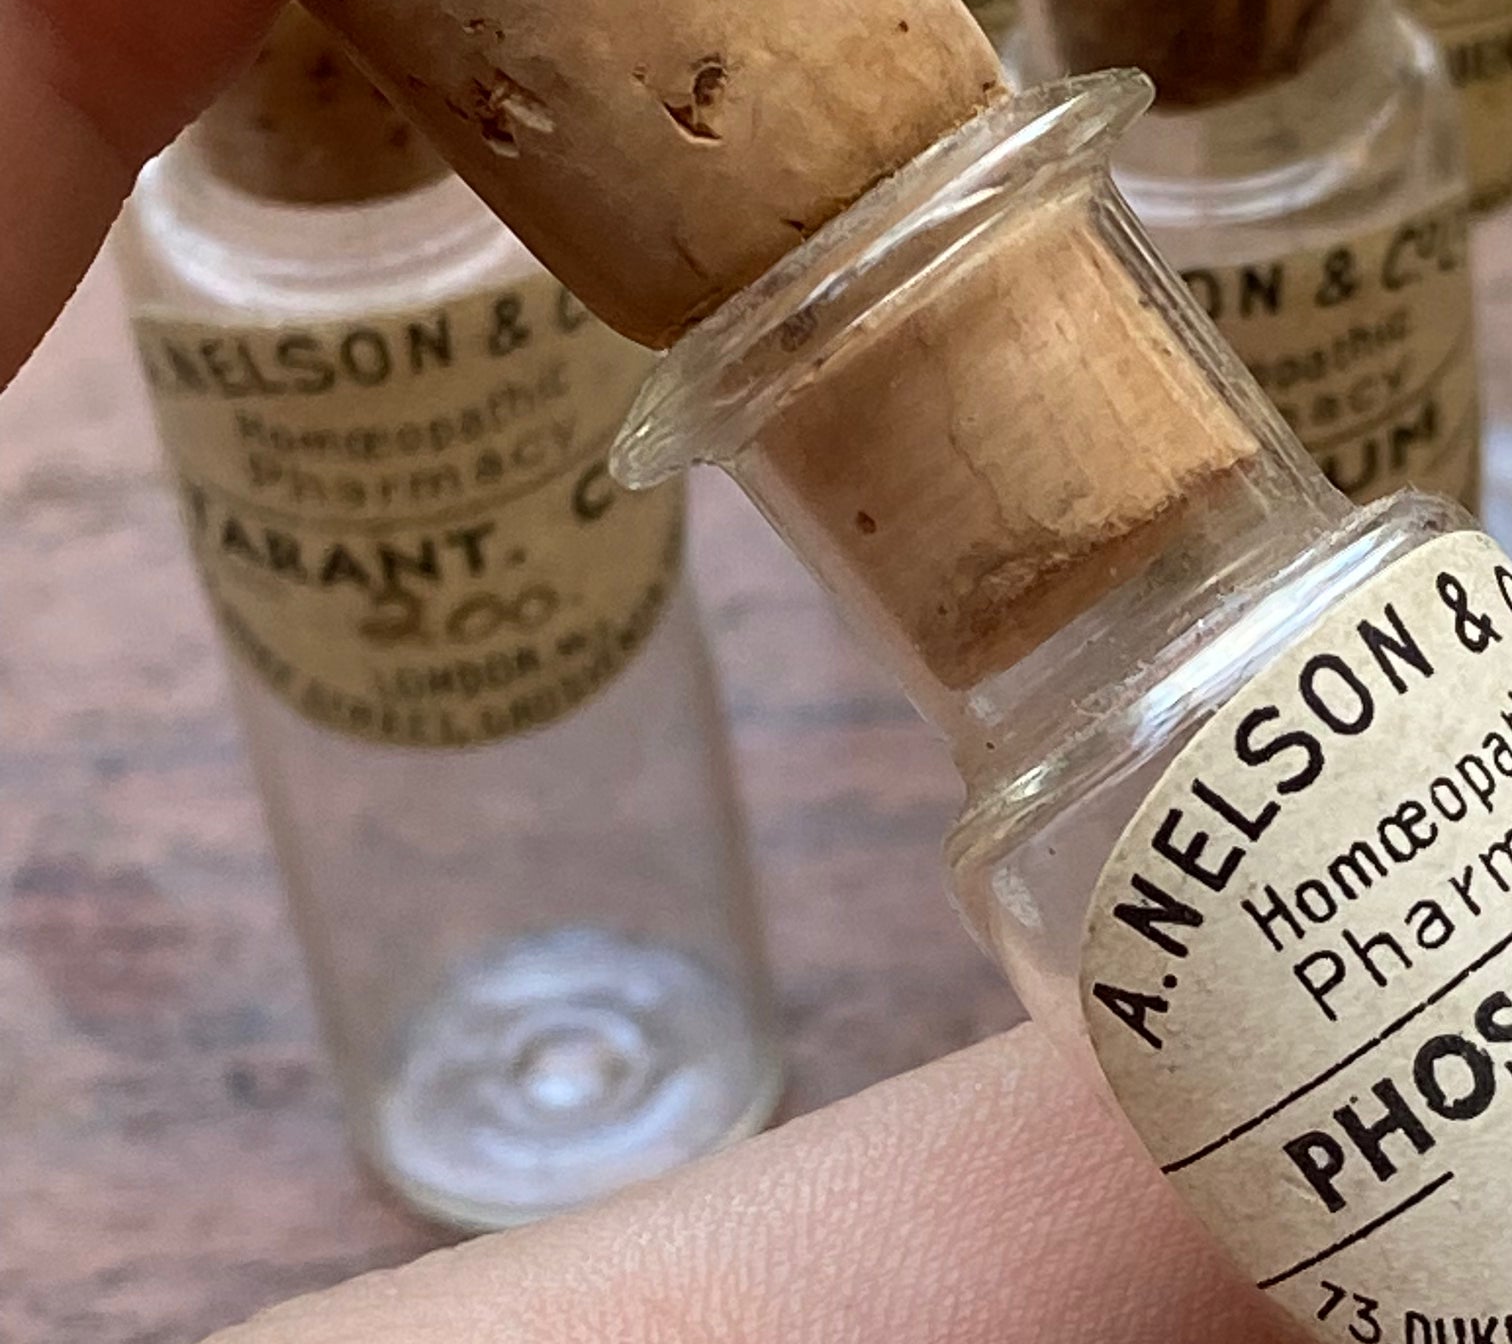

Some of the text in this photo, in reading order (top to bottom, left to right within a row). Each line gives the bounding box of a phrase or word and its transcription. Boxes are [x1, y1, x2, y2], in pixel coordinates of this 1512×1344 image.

[1313, 245, 1363, 308] &
[488, 293, 531, 357] &
[571, 460, 614, 523] C
[1435, 571, 1502, 653] &
